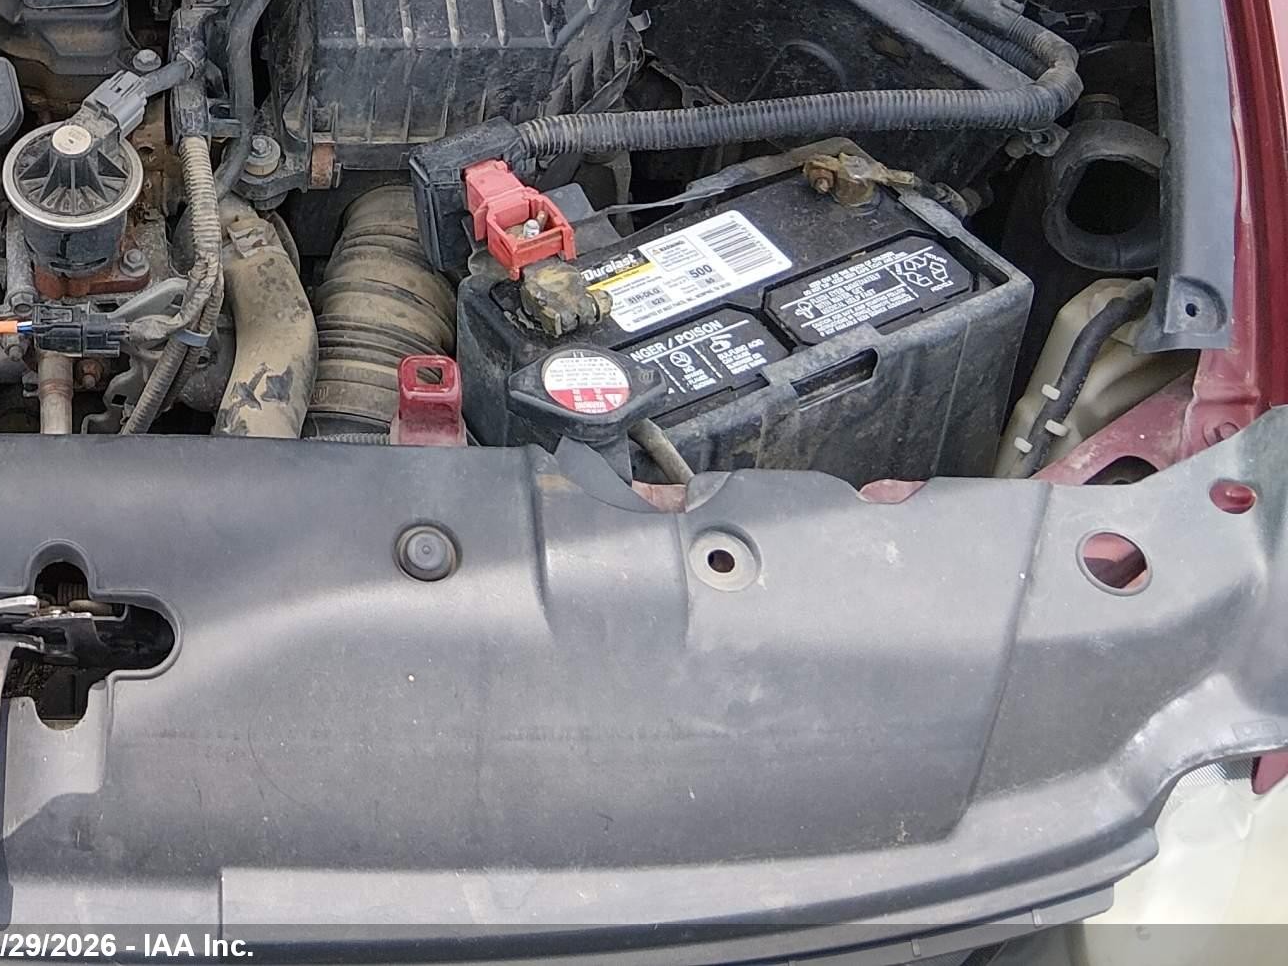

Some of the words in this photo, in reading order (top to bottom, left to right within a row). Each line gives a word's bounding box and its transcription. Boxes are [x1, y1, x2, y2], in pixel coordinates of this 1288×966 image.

[580, 253, 637, 282] Duralast
[689, 264, 713, 278] 500
[630, 342, 667, 362] NGER
[674, 320, 724, 344] POISON
